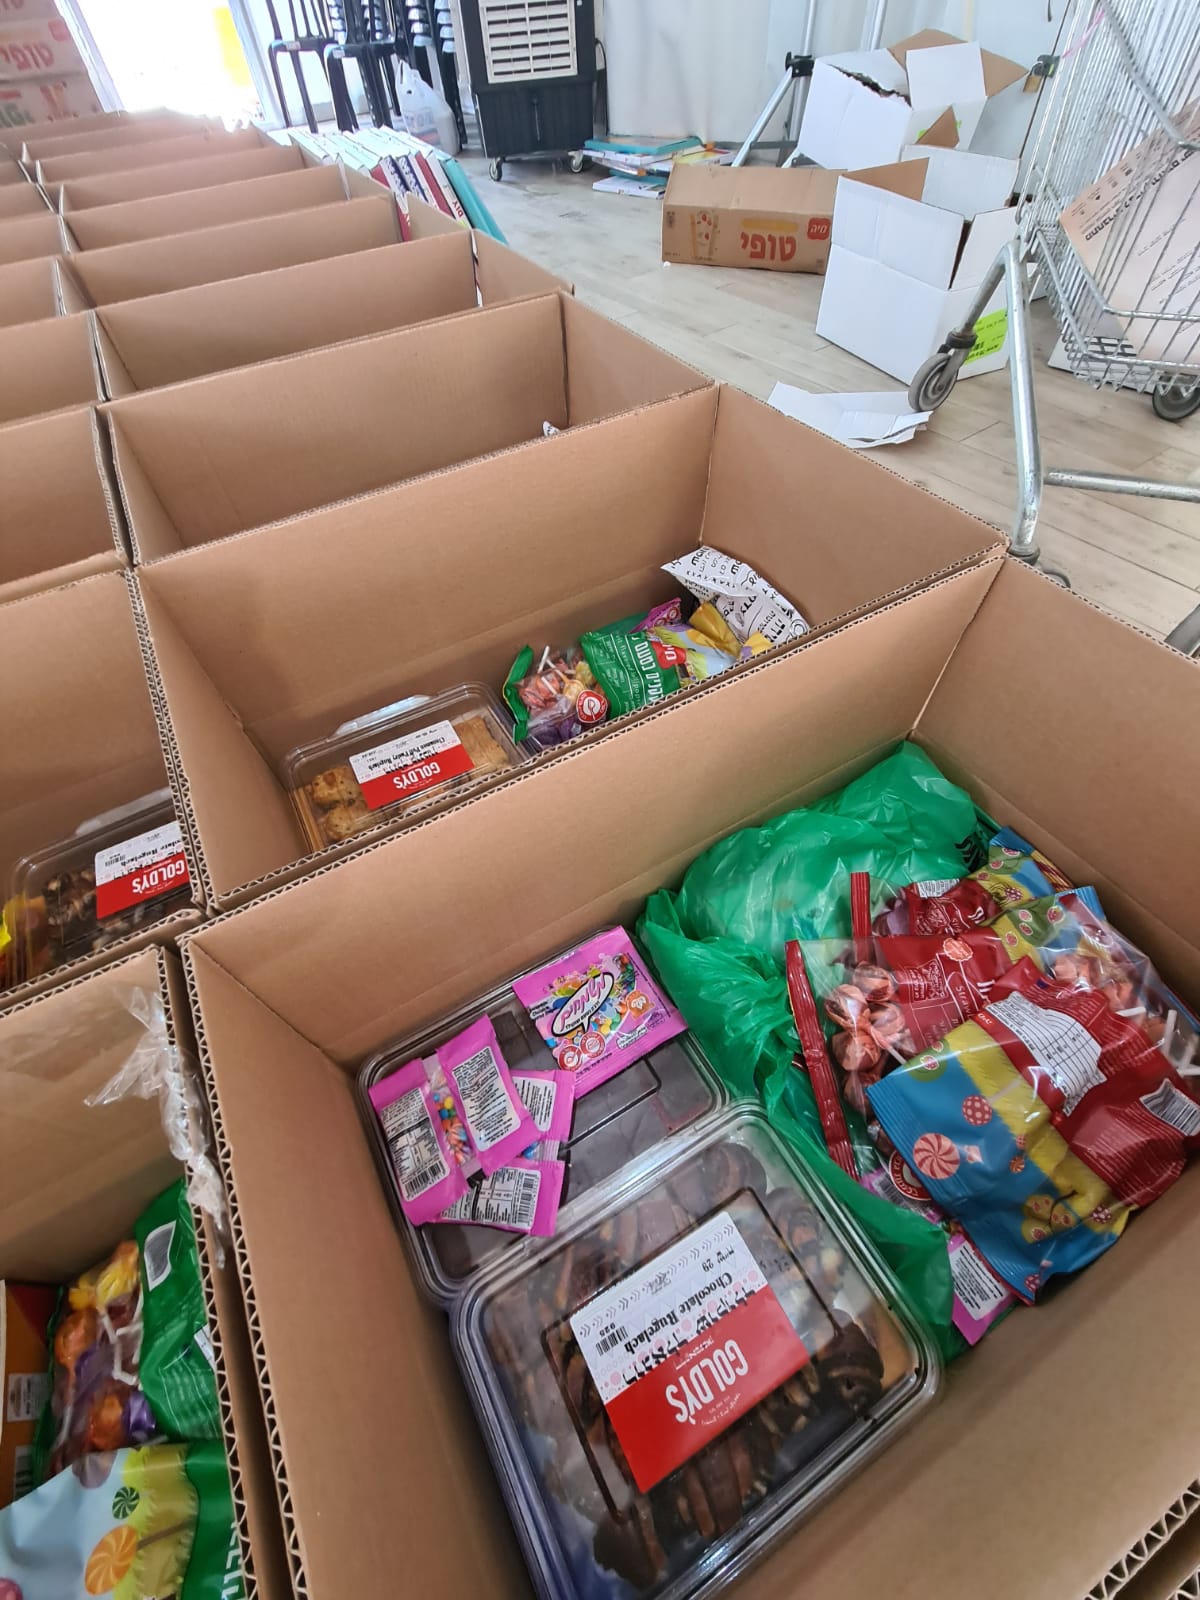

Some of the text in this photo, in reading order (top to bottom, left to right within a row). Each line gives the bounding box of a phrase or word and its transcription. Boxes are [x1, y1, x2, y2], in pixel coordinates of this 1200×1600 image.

[452, 200, 464, 218] DIY
[740, 232, 797, 262] טופי
[393, 761, 440, 789] GOLDY'S
[132, 860, 185, 893] GOLDY'S
[700, 1258, 714, 1272] 29
[677, 1272, 733, 1316] Chocolate
[694, 1285, 754, 1334] שוקולד
[598, 1322, 616, 1337] 925
[623, 1310, 679, 1355] Rugelach
[665, 1339, 749, 1425] GOLDY'S
